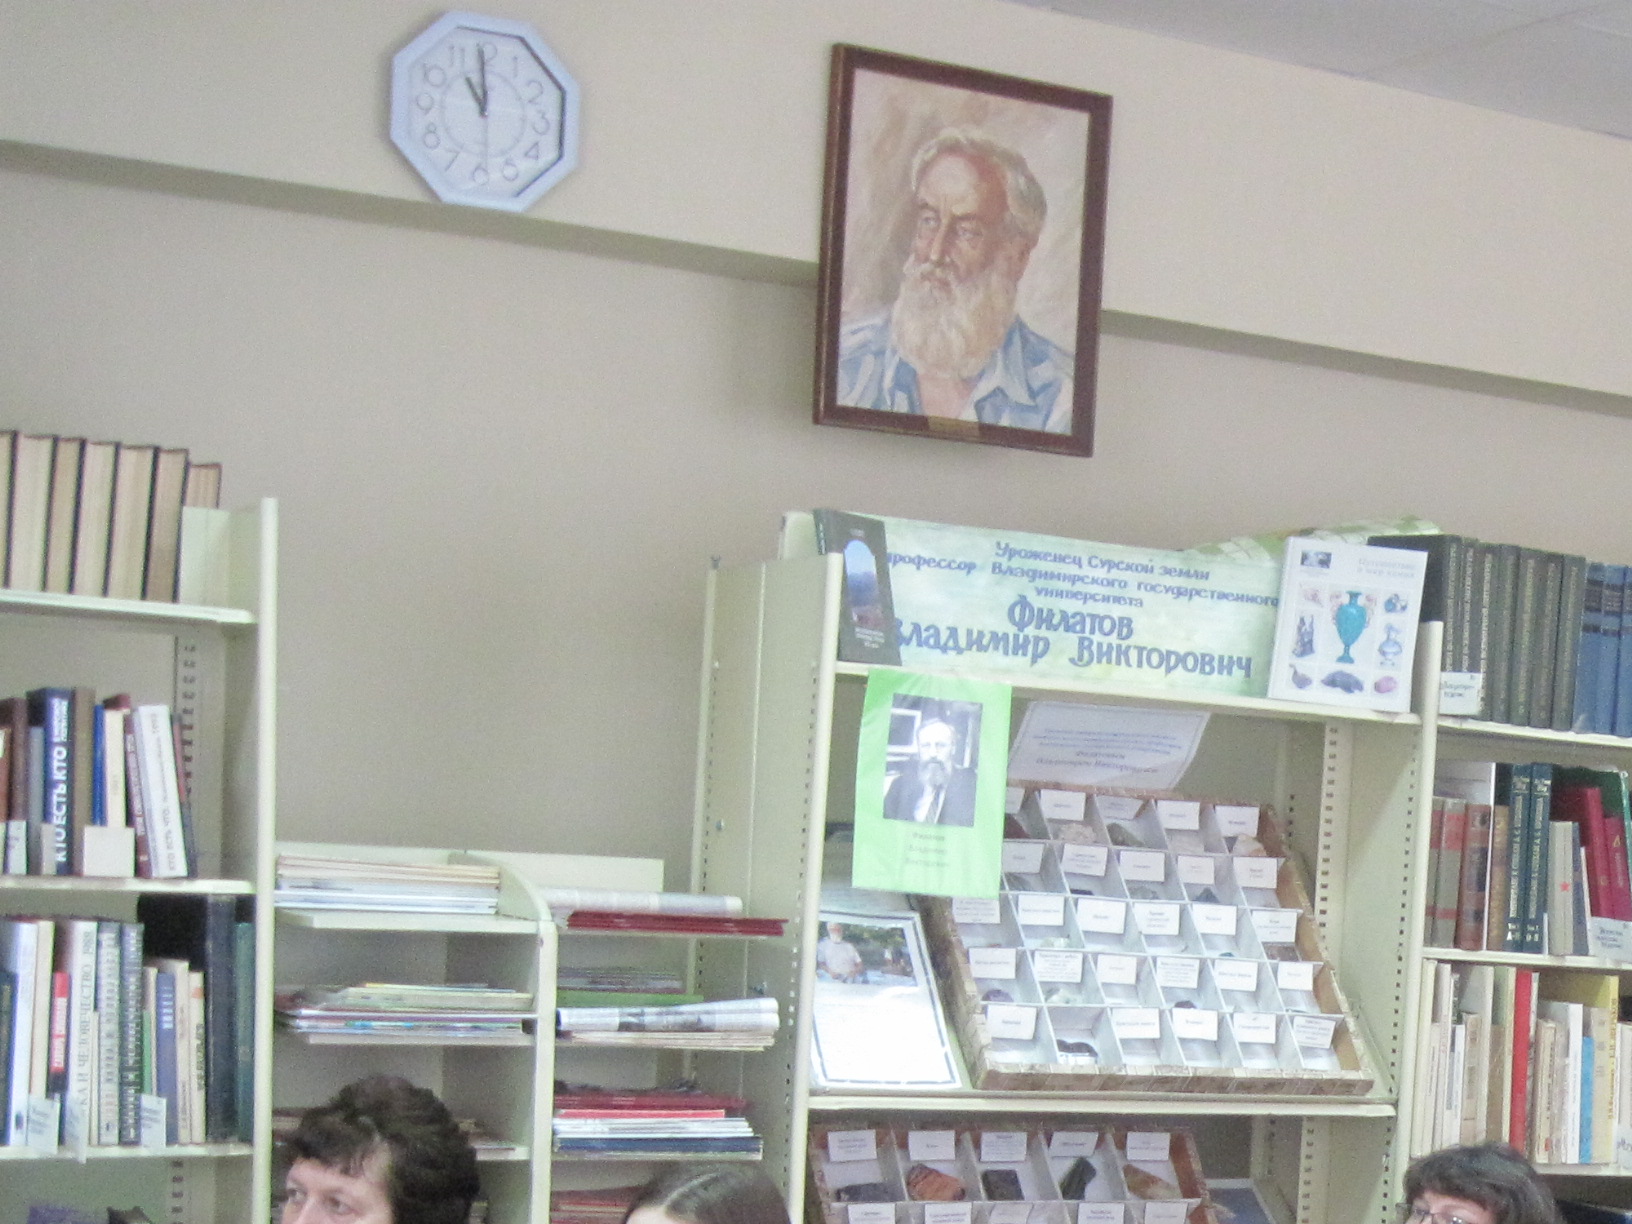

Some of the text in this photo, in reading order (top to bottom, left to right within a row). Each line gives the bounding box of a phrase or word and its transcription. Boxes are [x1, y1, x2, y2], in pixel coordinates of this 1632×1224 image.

[991, 562, 1128, 589] Владимирского
[995, 540, 1210, 581] Уроженец Сурской земли
[1007, 594, 1134, 641] Филатов
[1068, 636, 1252, 678] Викторович
[53, 746, 67, 780] КТО
[53, 784, 67, 825] ЕСТЬ
